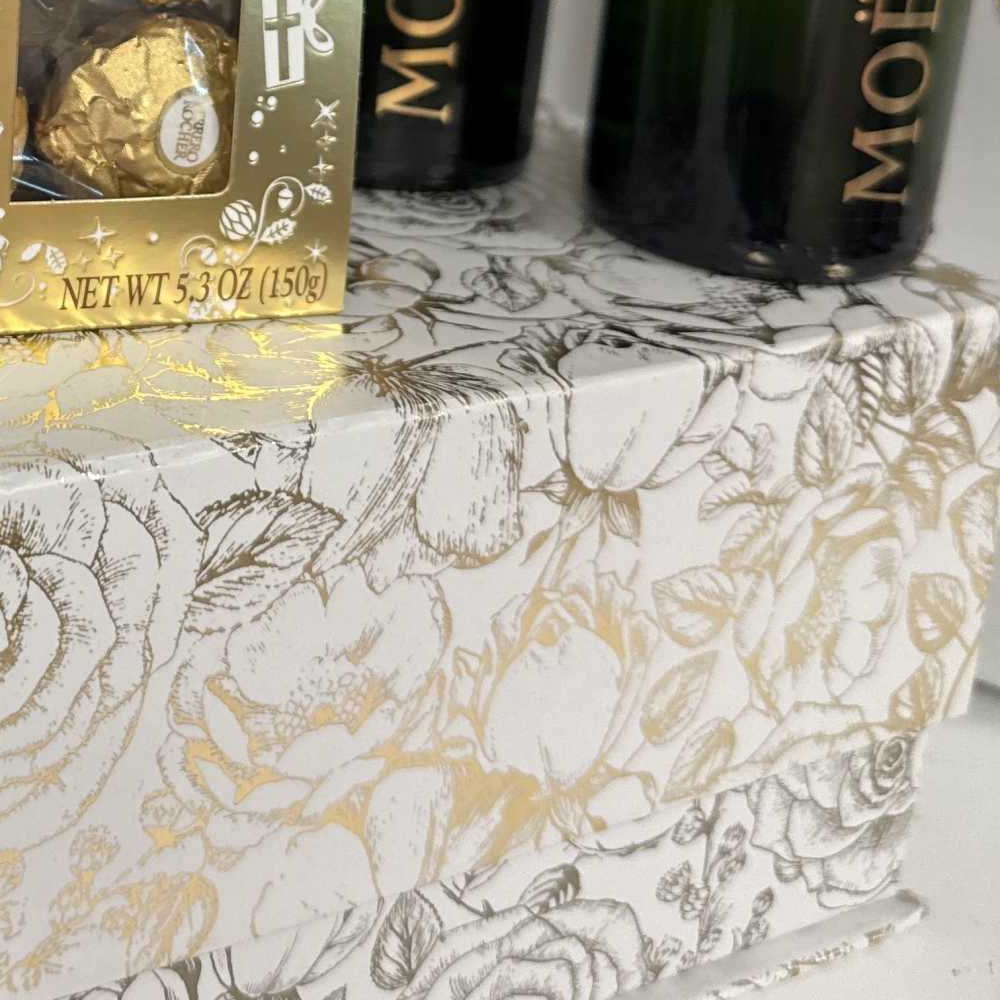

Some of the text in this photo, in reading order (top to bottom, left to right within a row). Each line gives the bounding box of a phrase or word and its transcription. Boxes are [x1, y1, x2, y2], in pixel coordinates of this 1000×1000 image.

[60, 262, 328, 310] NET WT 5.3 OZ (150g)
